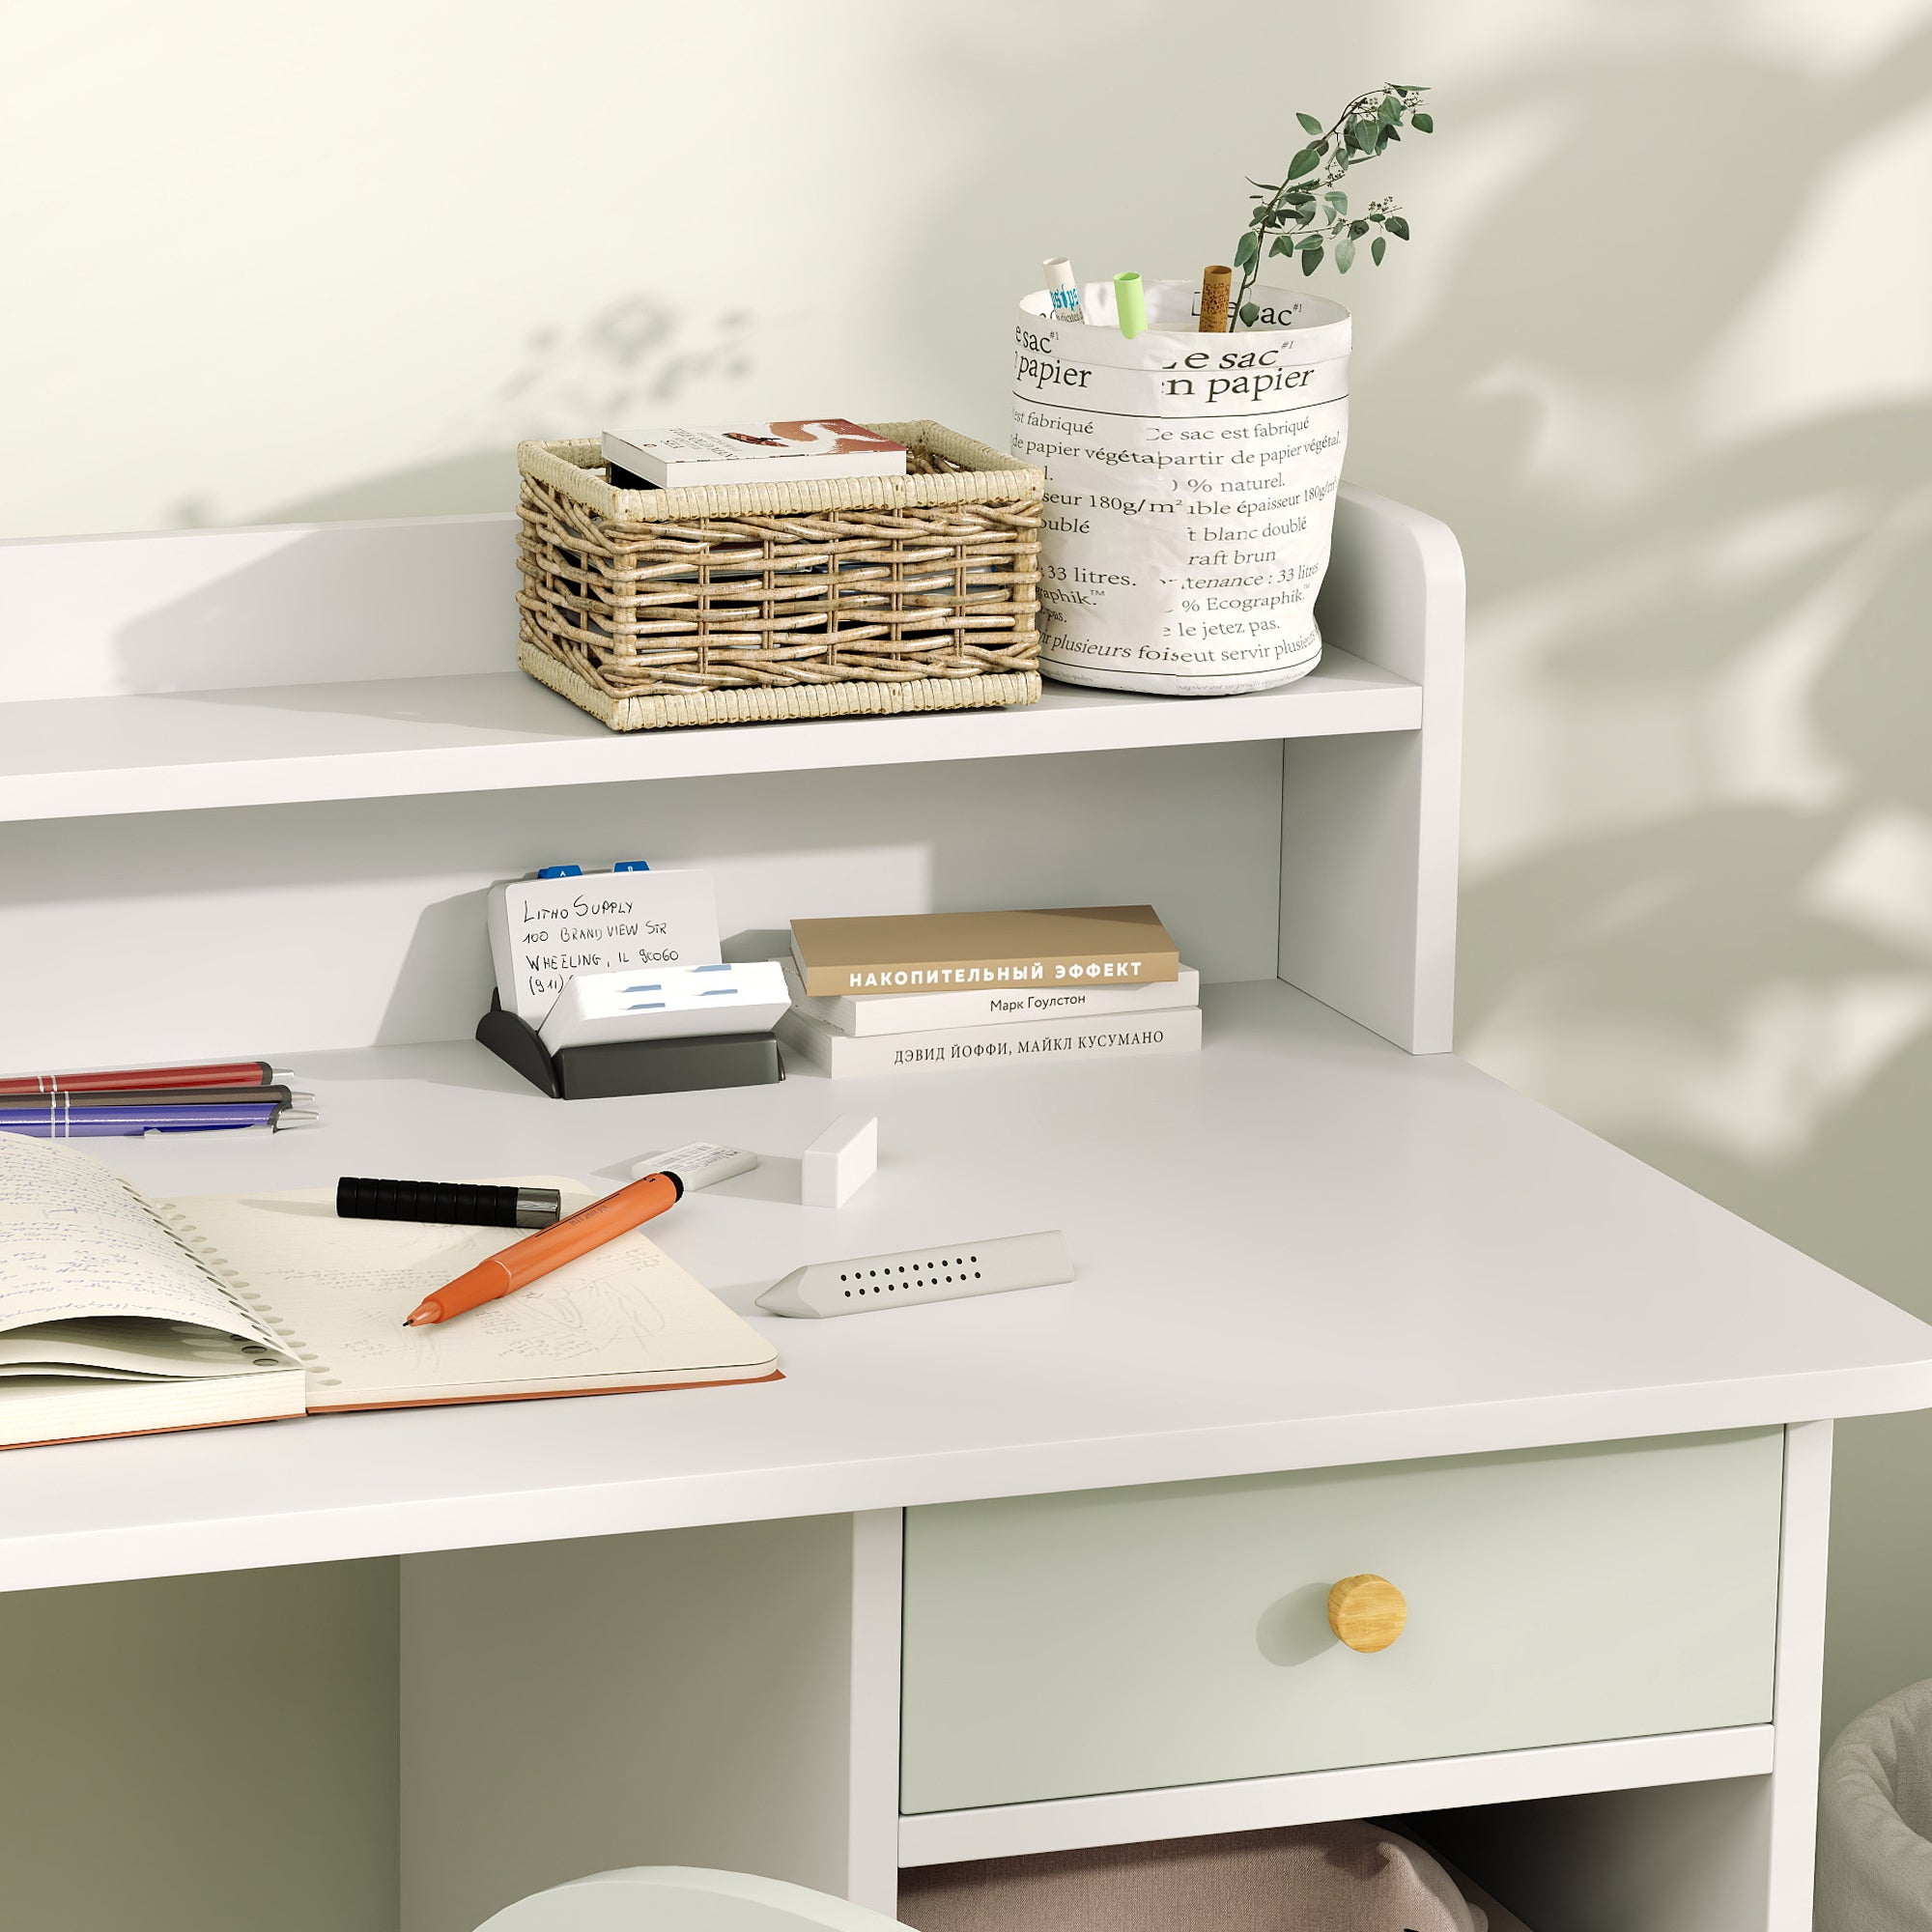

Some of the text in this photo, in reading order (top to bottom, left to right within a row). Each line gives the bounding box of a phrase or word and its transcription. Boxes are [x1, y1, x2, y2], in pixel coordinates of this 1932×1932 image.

[1017, 355, 1092, 389] papier
[1205, 368, 1315, 403] papier
[1027, 412, 1094, 435] fabriqué
[1179, 430, 1214, 440] sac
[1221, 427, 1249, 440] est
[1254, 416, 1310, 438] fabriqué
[1026, 440, 1080, 457] papier
[1231, 450, 1255, 464] de
[1260, 444, 1302, 466] papier
[1221, 472, 1285, 493] naturel.
[1042, 491, 1082, 506] seur
[1236, 495, 1300, 517] épaisseur
[1039, 517, 1091, 533] oublé
[1204, 526, 1258, 541] blanc
[1262, 516, 1307, 537] doublé
[1188, 551, 1276, 565] raft brun
[1074, 567, 1137, 586] litres.
[1181, 575, 1264, 589] tenance
[1277, 568, 1294, 583] 33
[1179, 622, 1197, 637] le
[1202, 622, 1245, 639] jetez
[1249, 619, 1280, 637] pas.
[1052, 635, 1132, 658] plusieurs
[1221, 643, 1270, 661] servir
[523, 931, 549, 944] 100
[618, 952, 630, 963] IL
[849, 961, 1143, 987] НАКОПИТЕЛЬНЫЙ ЭФФЕКТ
[990, 994, 1086, 1012] Марк Гоулстон
[895, 1030, 1164, 1065] ДЭВИД ЙОФФИ, МАЙКЛ КУСУМАНО
